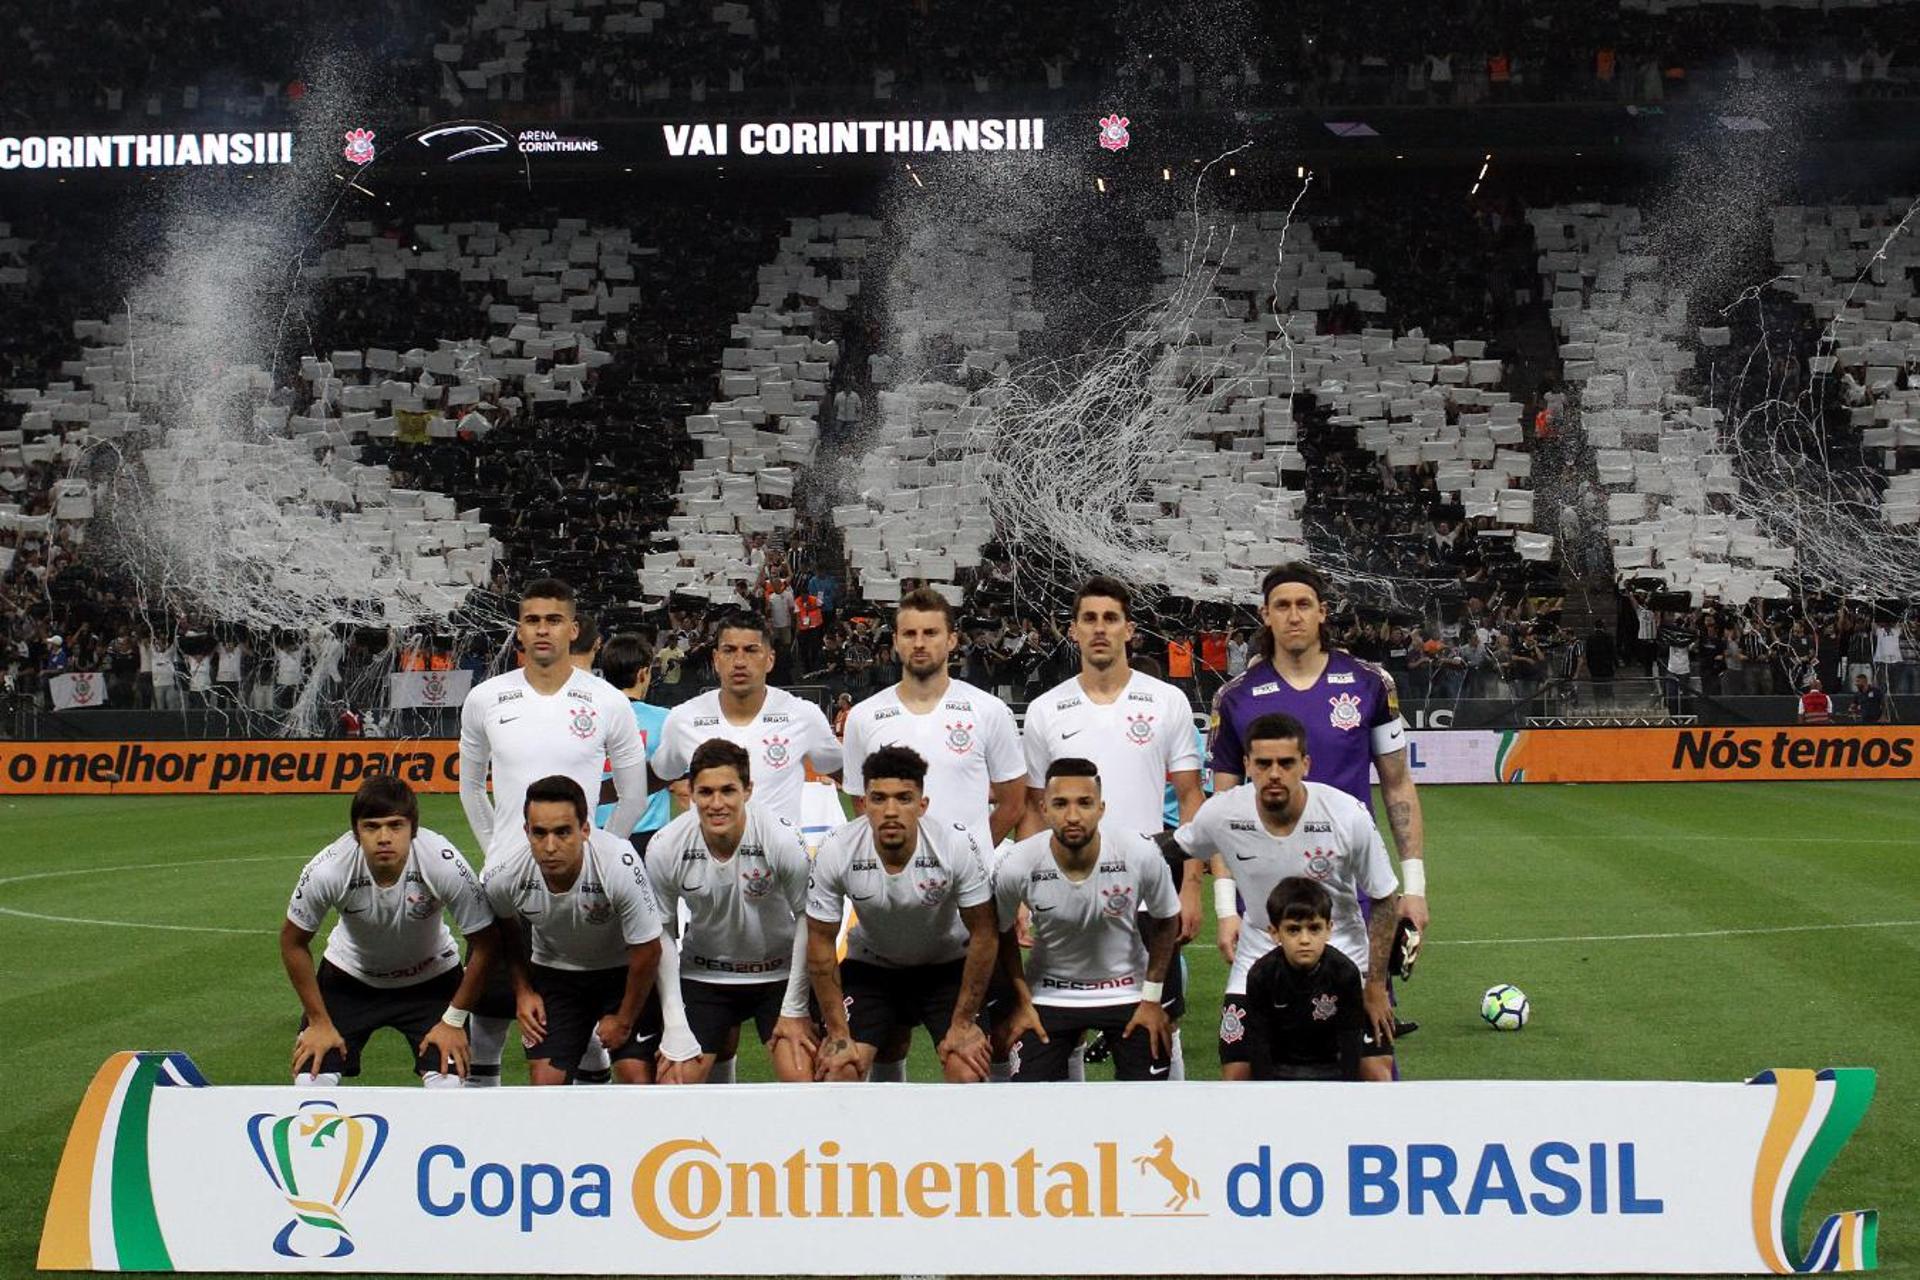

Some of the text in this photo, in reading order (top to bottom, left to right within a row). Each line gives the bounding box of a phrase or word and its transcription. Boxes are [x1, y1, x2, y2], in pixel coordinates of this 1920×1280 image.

[518, 140, 599, 152] CORINTHIANS
[519, 131, 557, 141] ARENA
[663, 123, 728, 156] VAI
[8, 753, 37, 783] o
[43, 745, 207, 783] melhor
[208, 752, 327, 790] pneu
[330, 751, 435, 790] para
[1671, 730, 1914, 770] Nós temos
[417, 1137, 1663, 1241] Copa Continental do BRASIL
